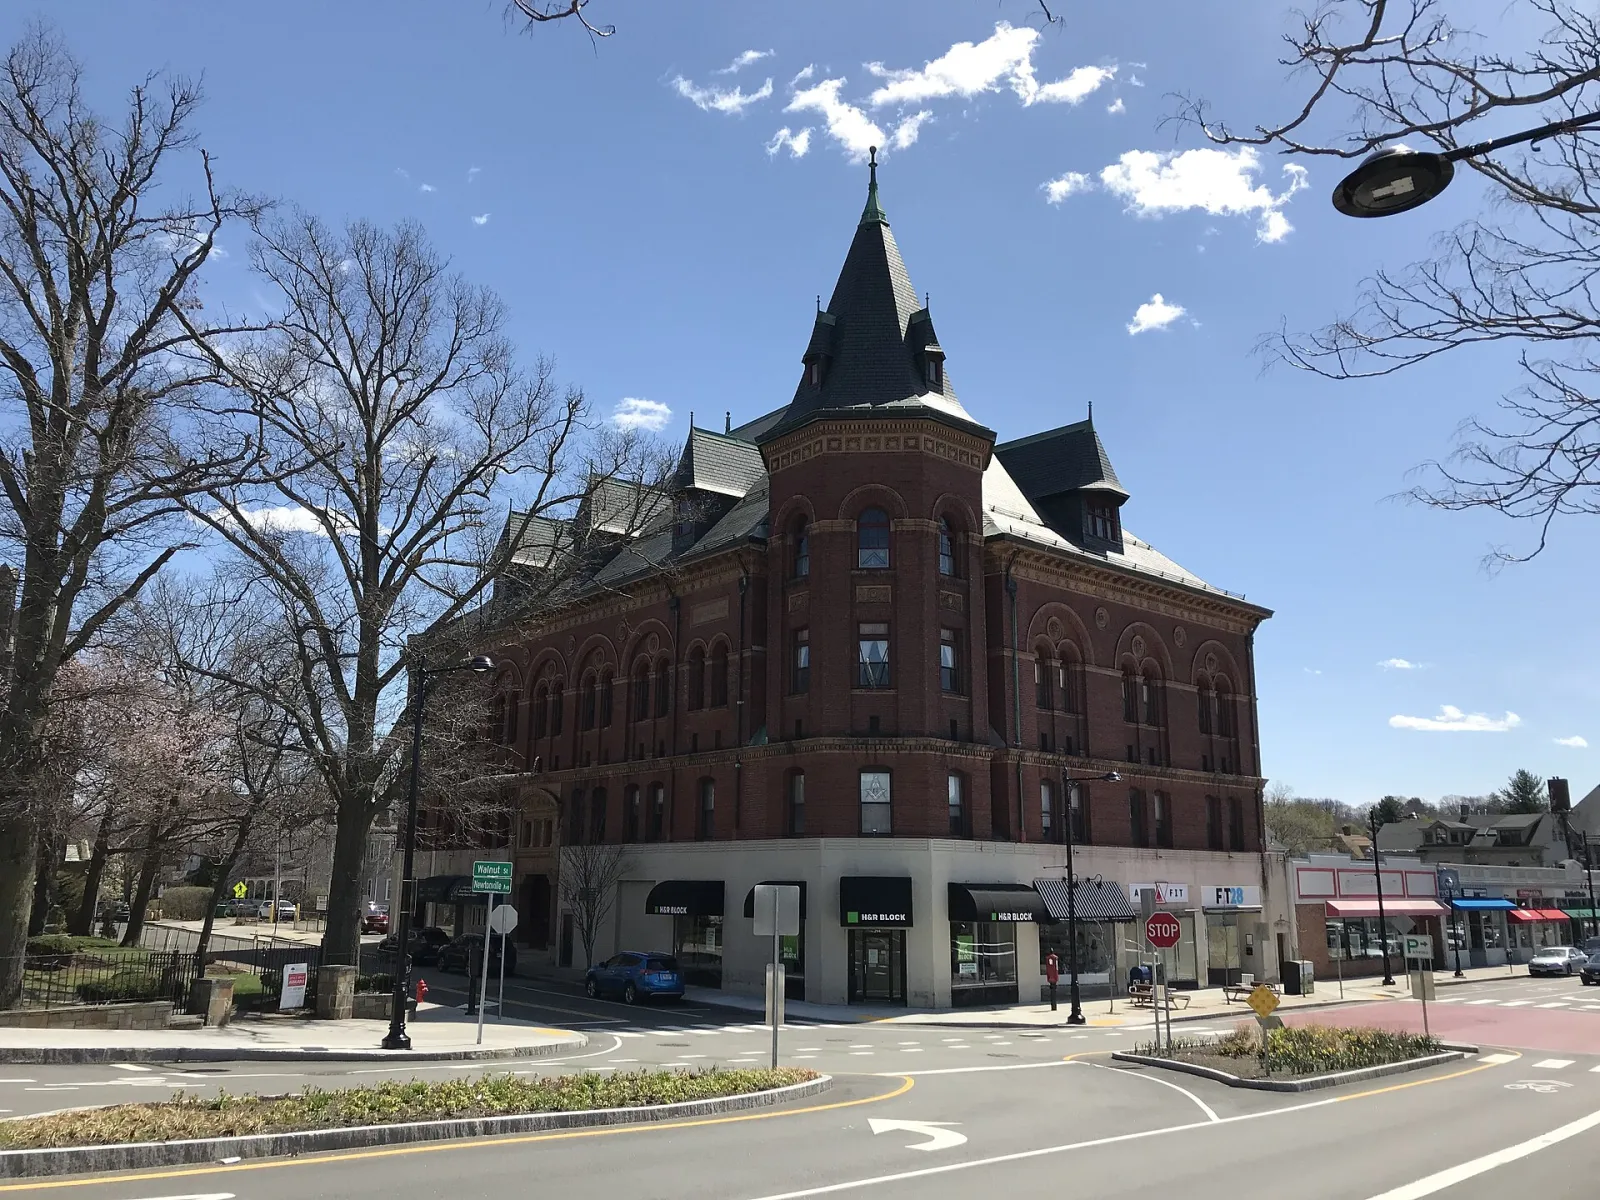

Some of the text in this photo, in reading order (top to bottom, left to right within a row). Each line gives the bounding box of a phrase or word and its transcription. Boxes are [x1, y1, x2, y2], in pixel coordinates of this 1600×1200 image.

[477, 864, 500, 874] Walnut
[474, 880, 501, 890] Newtonville
[1169, 888, 1184, 897] FIT
[660, 906, 687, 914] H&R BLOCK
[861, 913, 906, 921] H&R BLOCK
[998, 912, 1033, 921] H&R BLOCK
[1148, 923, 1179, 938] STOP
